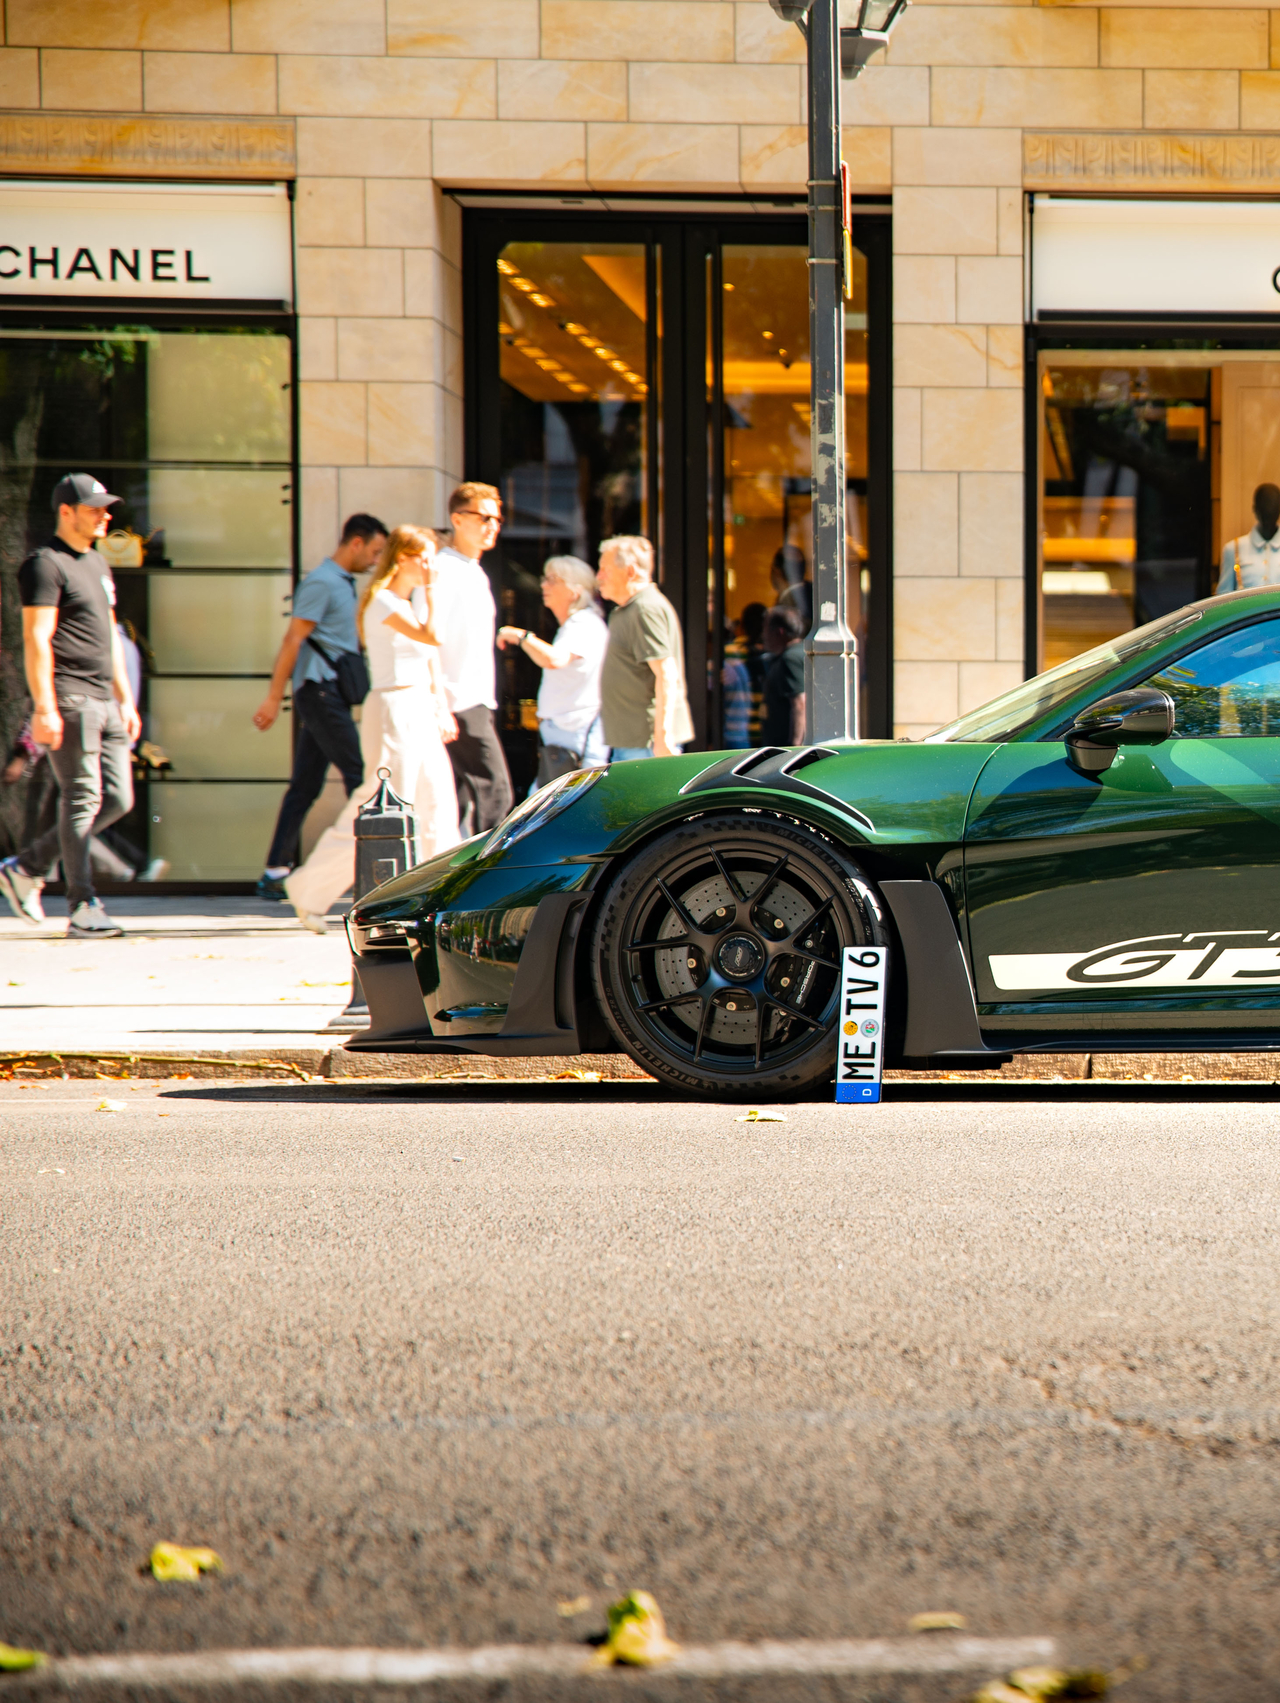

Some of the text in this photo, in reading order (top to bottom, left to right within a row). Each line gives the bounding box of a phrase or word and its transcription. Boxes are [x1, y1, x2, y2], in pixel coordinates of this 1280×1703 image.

[0, 245, 210, 282] CHANEL
[777, 828, 843, 874] MICHELIN
[848, 950, 880, 968] 6
[845, 977, 879, 1016] TV
[631, 1039, 699, 1087] MICHELIN
[842, 1041, 877, 1080] ME
[862, 1088, 872, 1096] D
